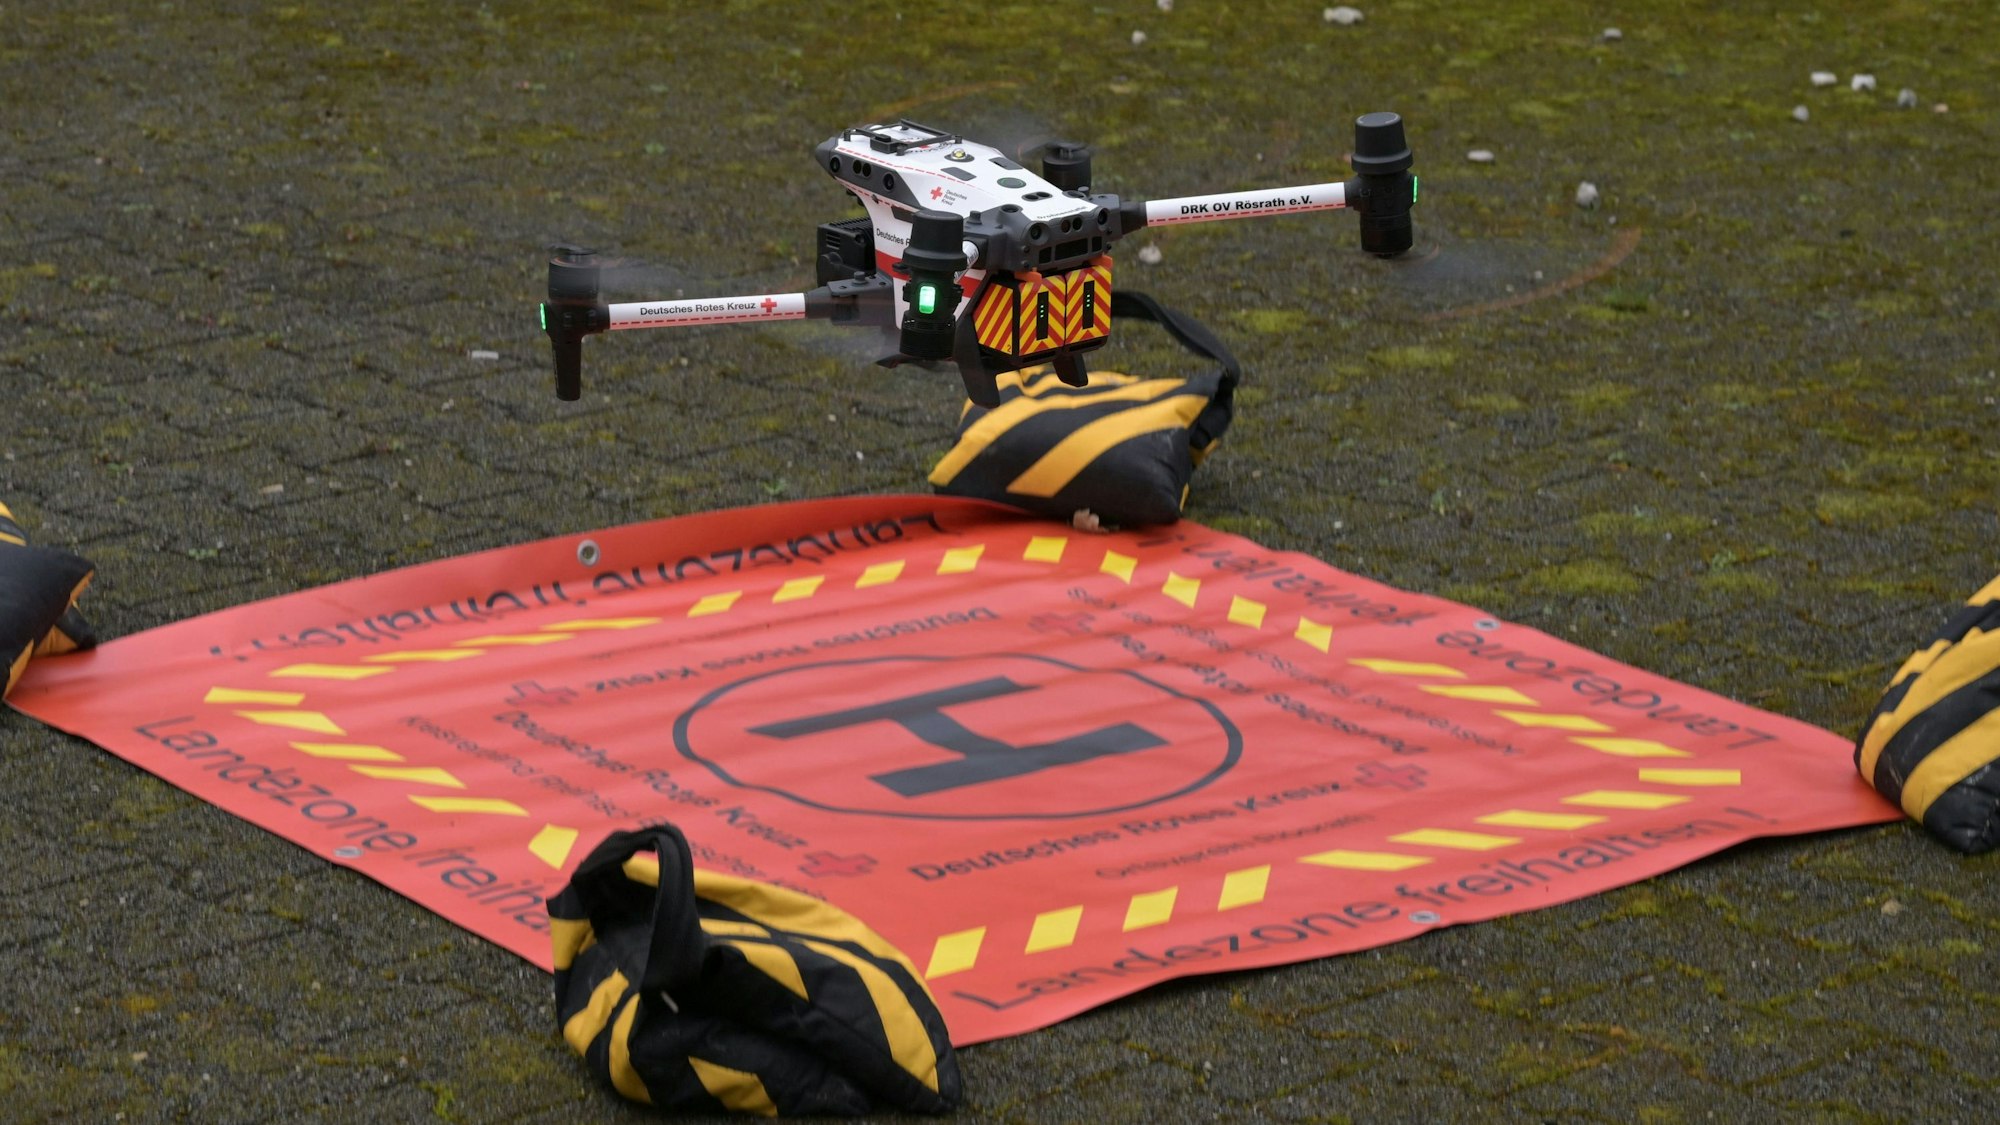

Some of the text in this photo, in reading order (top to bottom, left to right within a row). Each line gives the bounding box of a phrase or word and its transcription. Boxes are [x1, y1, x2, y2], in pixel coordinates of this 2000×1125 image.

[876, 228, 904, 245] Deutsches
[1181, 195, 1313, 215] DRK OV Rösrath e.V.
[640, 302, 756, 316] Deutsches Rotes Kreuz
[134, 715, 418, 851] Landezone
[750, 677, 1166, 799] H
[908, 780, 1344, 882] Deutsches Rotes Kreuz
[951, 900, 1400, 1012] Landezone
[1395, 818, 1744, 906] freihalten
